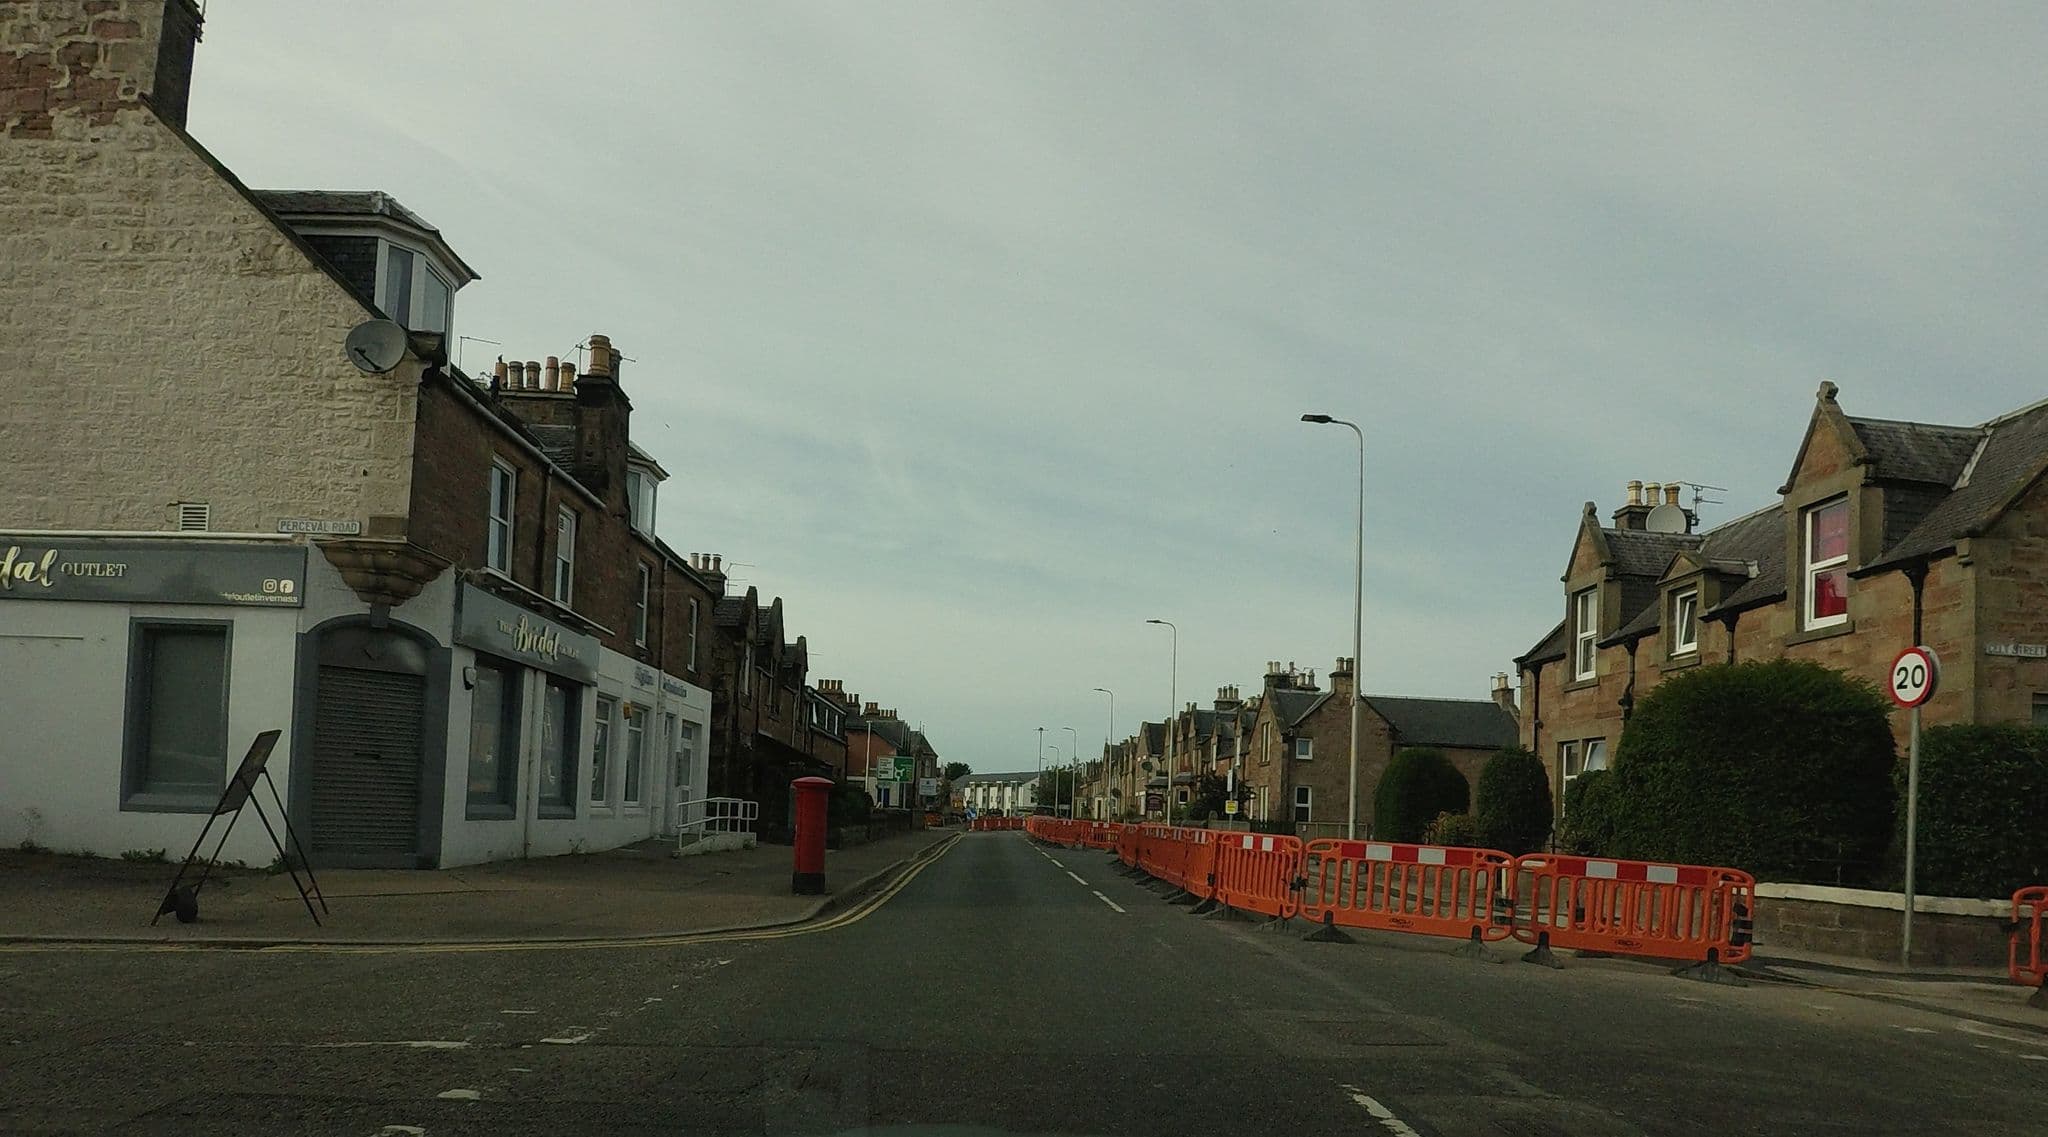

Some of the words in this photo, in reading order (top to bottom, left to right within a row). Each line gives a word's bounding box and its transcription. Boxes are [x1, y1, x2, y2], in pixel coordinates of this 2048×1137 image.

[280, 520, 328, 532] PERCEVAL
[332, 522, 358, 533] ROAD
[61, 562, 127, 577] OUTLET
[514, 614, 560, 661] Bridal
[1896, 664, 1925, 690] 20
